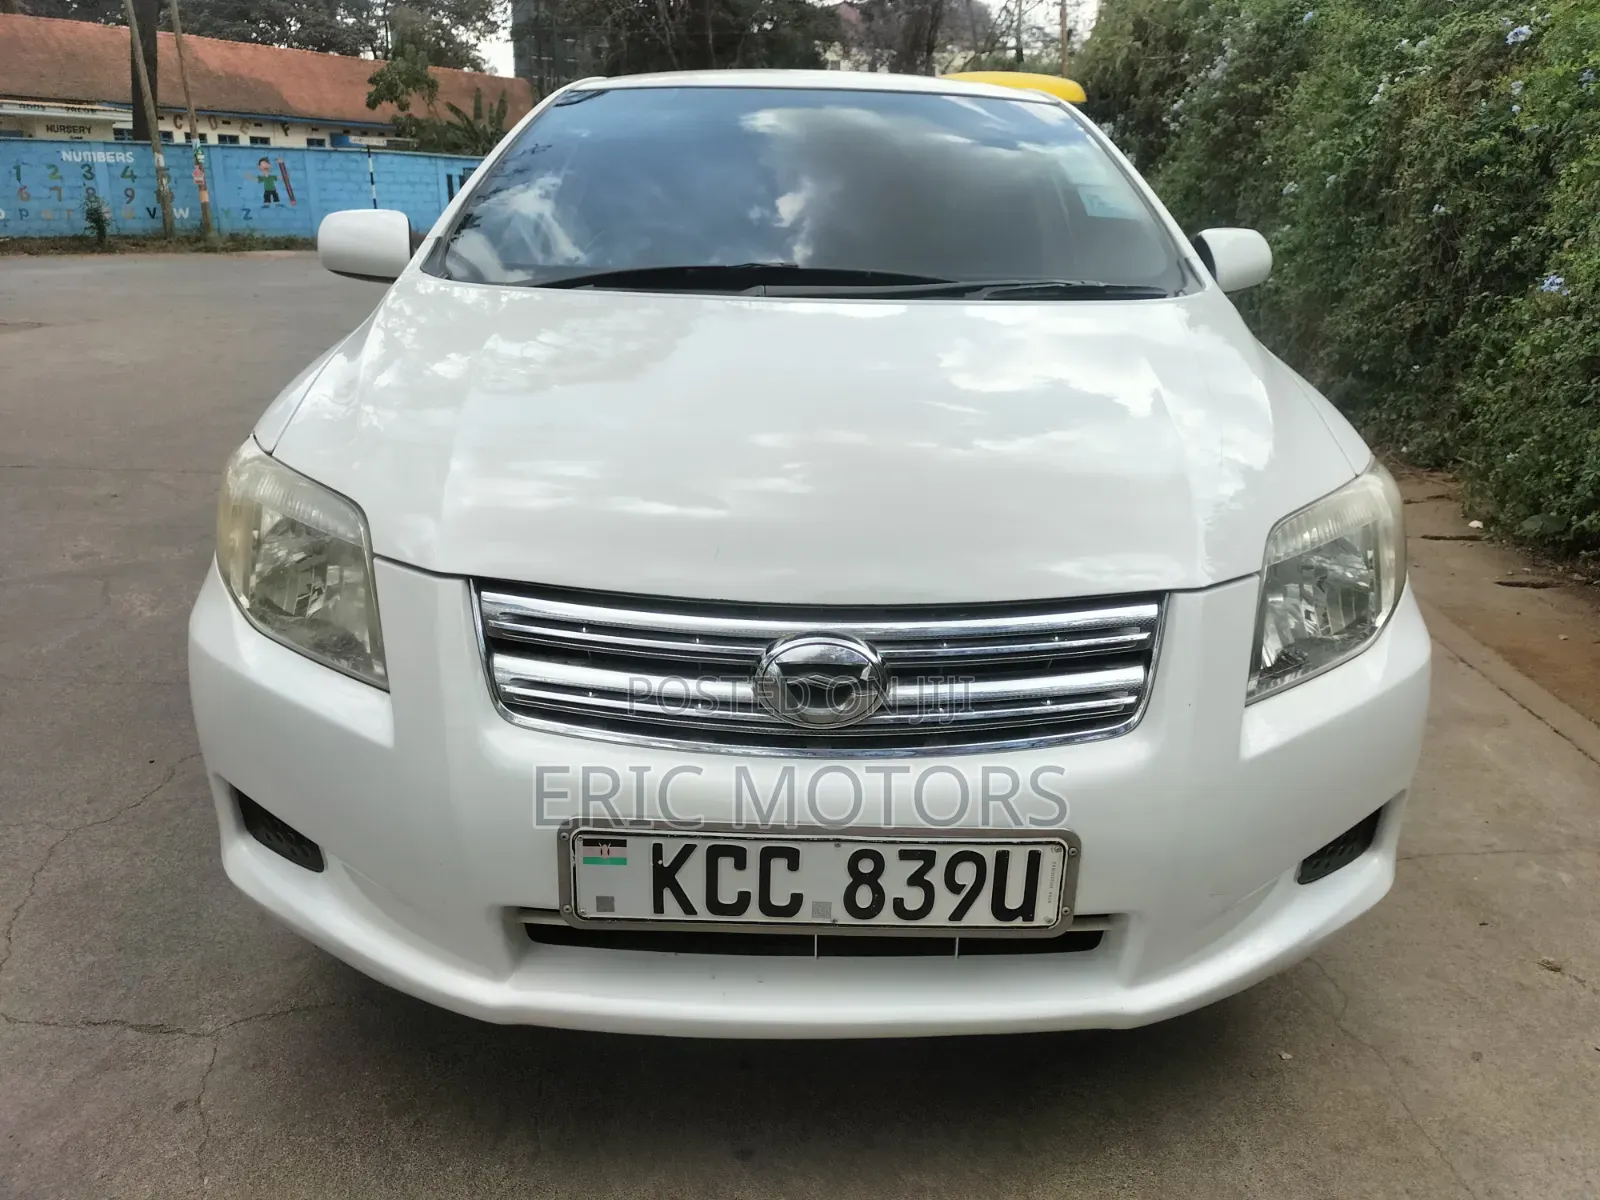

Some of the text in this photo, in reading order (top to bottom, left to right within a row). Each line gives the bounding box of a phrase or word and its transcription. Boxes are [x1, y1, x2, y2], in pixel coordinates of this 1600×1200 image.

[45, 124, 92, 134] NURSERY
[61, 151, 135, 162] NUMBERS
[13, 164, 137, 183] 1 2 3 4
[18, 185, 31, 202] 6
[49, 186, 62, 202] 7
[124, 187, 135, 204] 9
[652, 843, 1042, 922] KCC 839U
